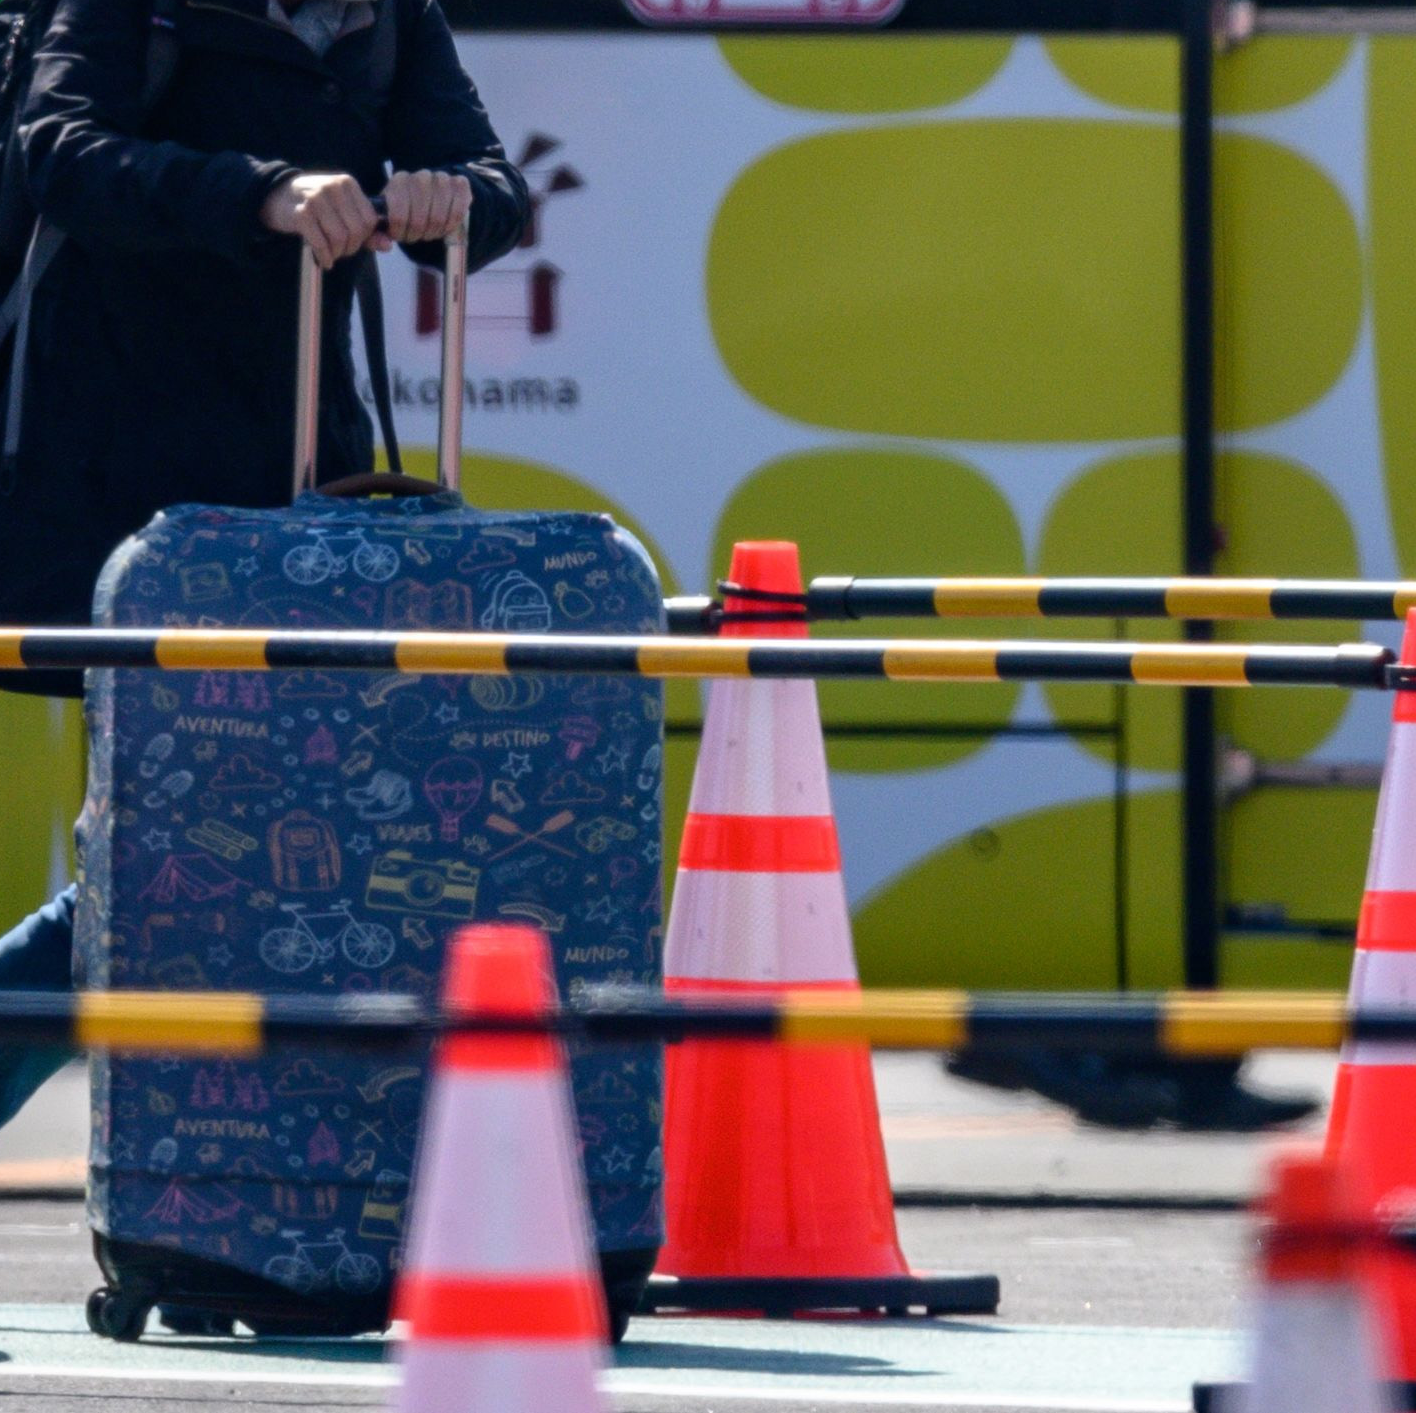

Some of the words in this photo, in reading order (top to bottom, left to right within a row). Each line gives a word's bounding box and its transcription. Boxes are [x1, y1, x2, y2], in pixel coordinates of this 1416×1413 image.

[544, 551, 598, 572] MUNDO
[173, 715, 269, 741] AVENTURA
[482, 729, 551, 748] DESTINO
[564, 944, 630, 964] MUNDO
[173, 1118, 271, 1141] AVENTURA
